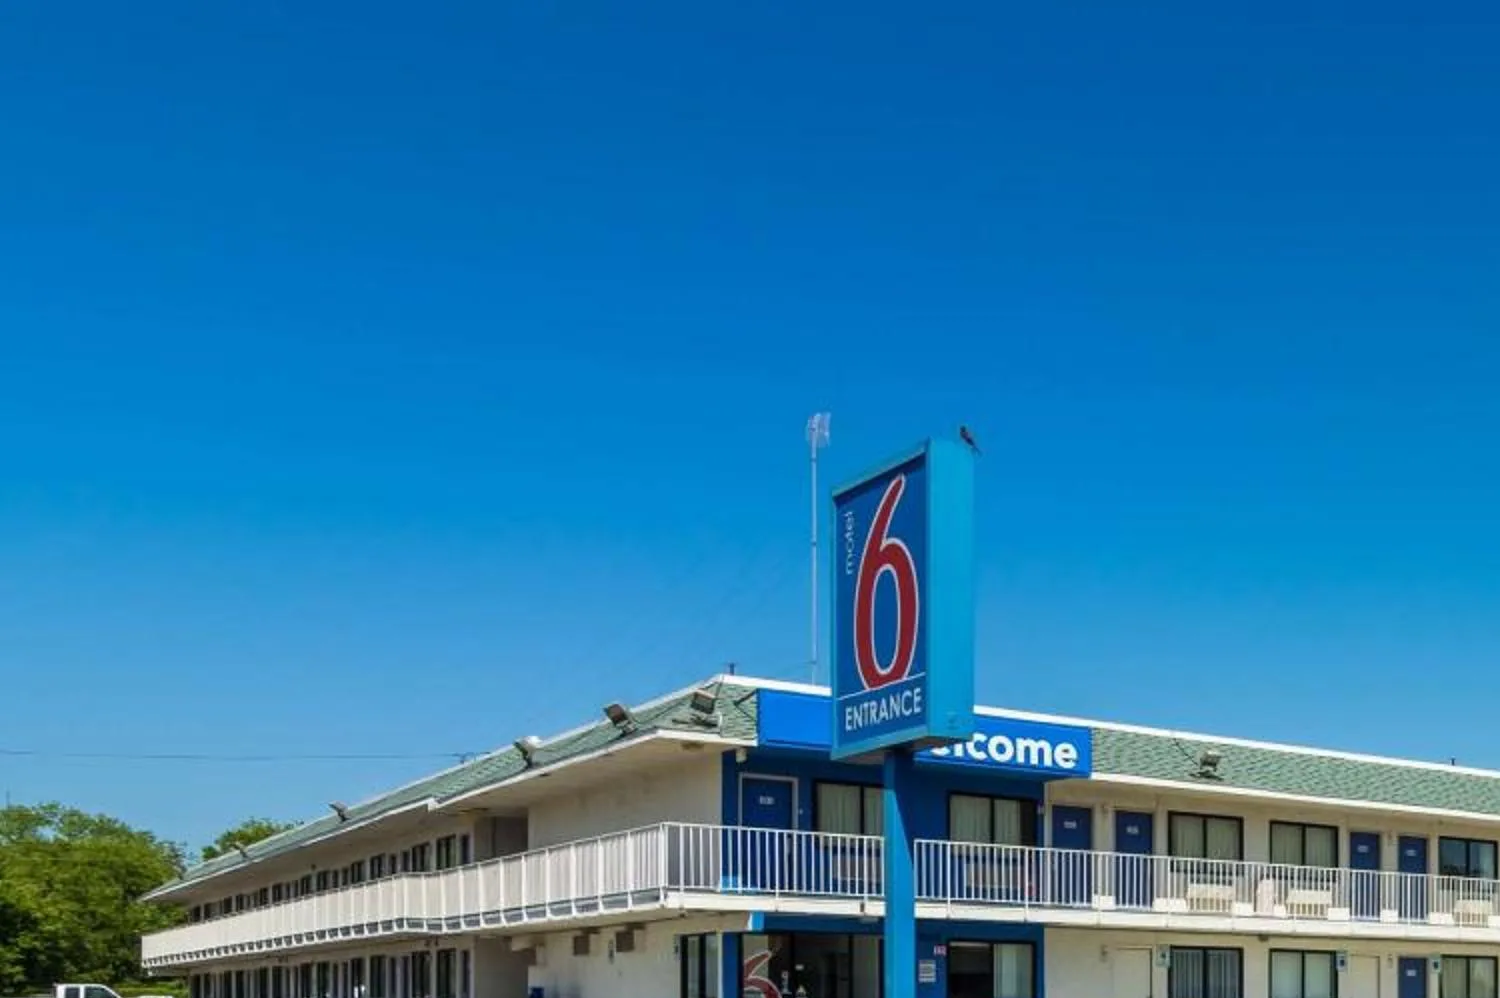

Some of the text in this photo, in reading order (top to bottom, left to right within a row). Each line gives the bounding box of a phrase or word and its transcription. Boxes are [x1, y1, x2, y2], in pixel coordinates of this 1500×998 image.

[844, 511, 856, 575] motel
[853, 473, 919, 690] 6
[845, 687, 922, 731] ENTRANCE
[930, 732, 1079, 769] come
